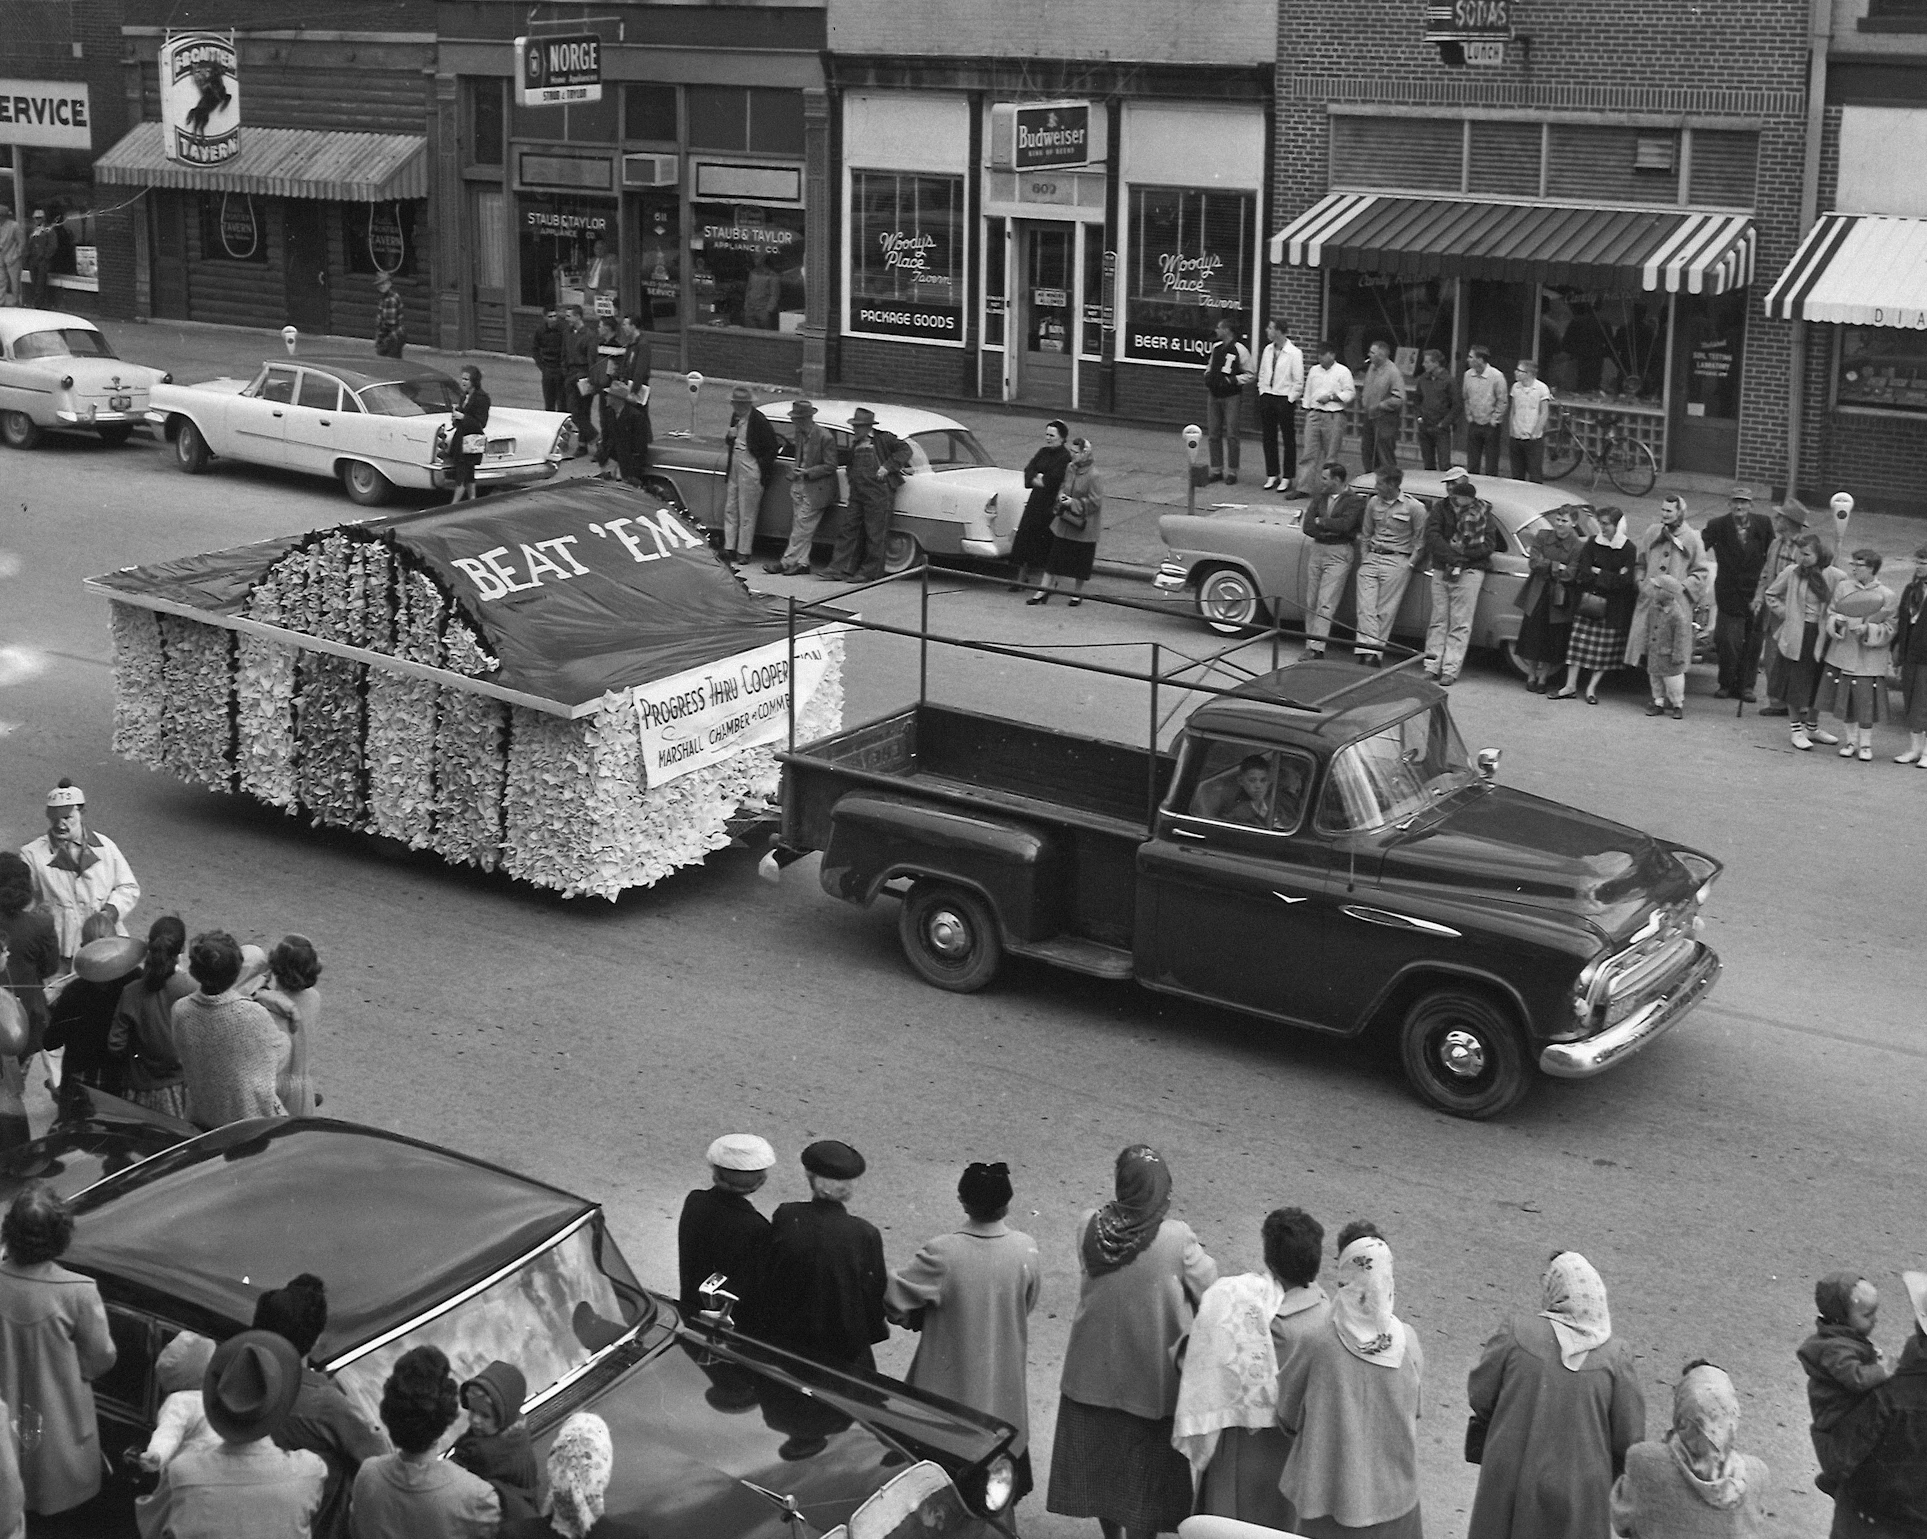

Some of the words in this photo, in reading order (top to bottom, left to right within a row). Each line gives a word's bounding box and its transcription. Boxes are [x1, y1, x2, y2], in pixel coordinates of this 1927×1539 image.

[1456, 0, 1507, 26] SODAS
[174, 46, 237, 73] FRONTIER
[550, 43, 597, 72] NORGE
[0, 95, 87, 127] ERVICE
[1018, 124, 1084, 149] Budweiser
[180, 137, 237, 162] TAVERN
[527, 212, 559, 226] STAUB
[568, 216, 606, 231] TAYLOR
[703, 225, 740, 240] STAUB
[741, 228, 748, 241] &
[752, 229, 793, 244] TAYLOR
[713, 241, 760, 252] APPLIANCE
[879, 231, 937, 258] Woody's
[884, 250, 931, 271] Place
[1158, 250, 1224, 279] Woody's
[911, 270, 952, 285] Tavern
[1162, 272, 1211, 293] Place
[1198, 294, 1243, 311] Tavern
[860, 309, 911, 325] PACKAGE
[913, 313, 955, 329] GOODS
[1134, 334, 1169, 350] BEER
[1170, 338, 1181, 351] &
[450, 535, 590, 602] BEAT
[588, 508, 704, 563] 'EM
[639, 686, 706, 730] PROGRESS
[704, 675, 739, 707] THRU
[658, 736, 704, 769] MARSHALL
[708, 711, 751, 745] CHAMBER
